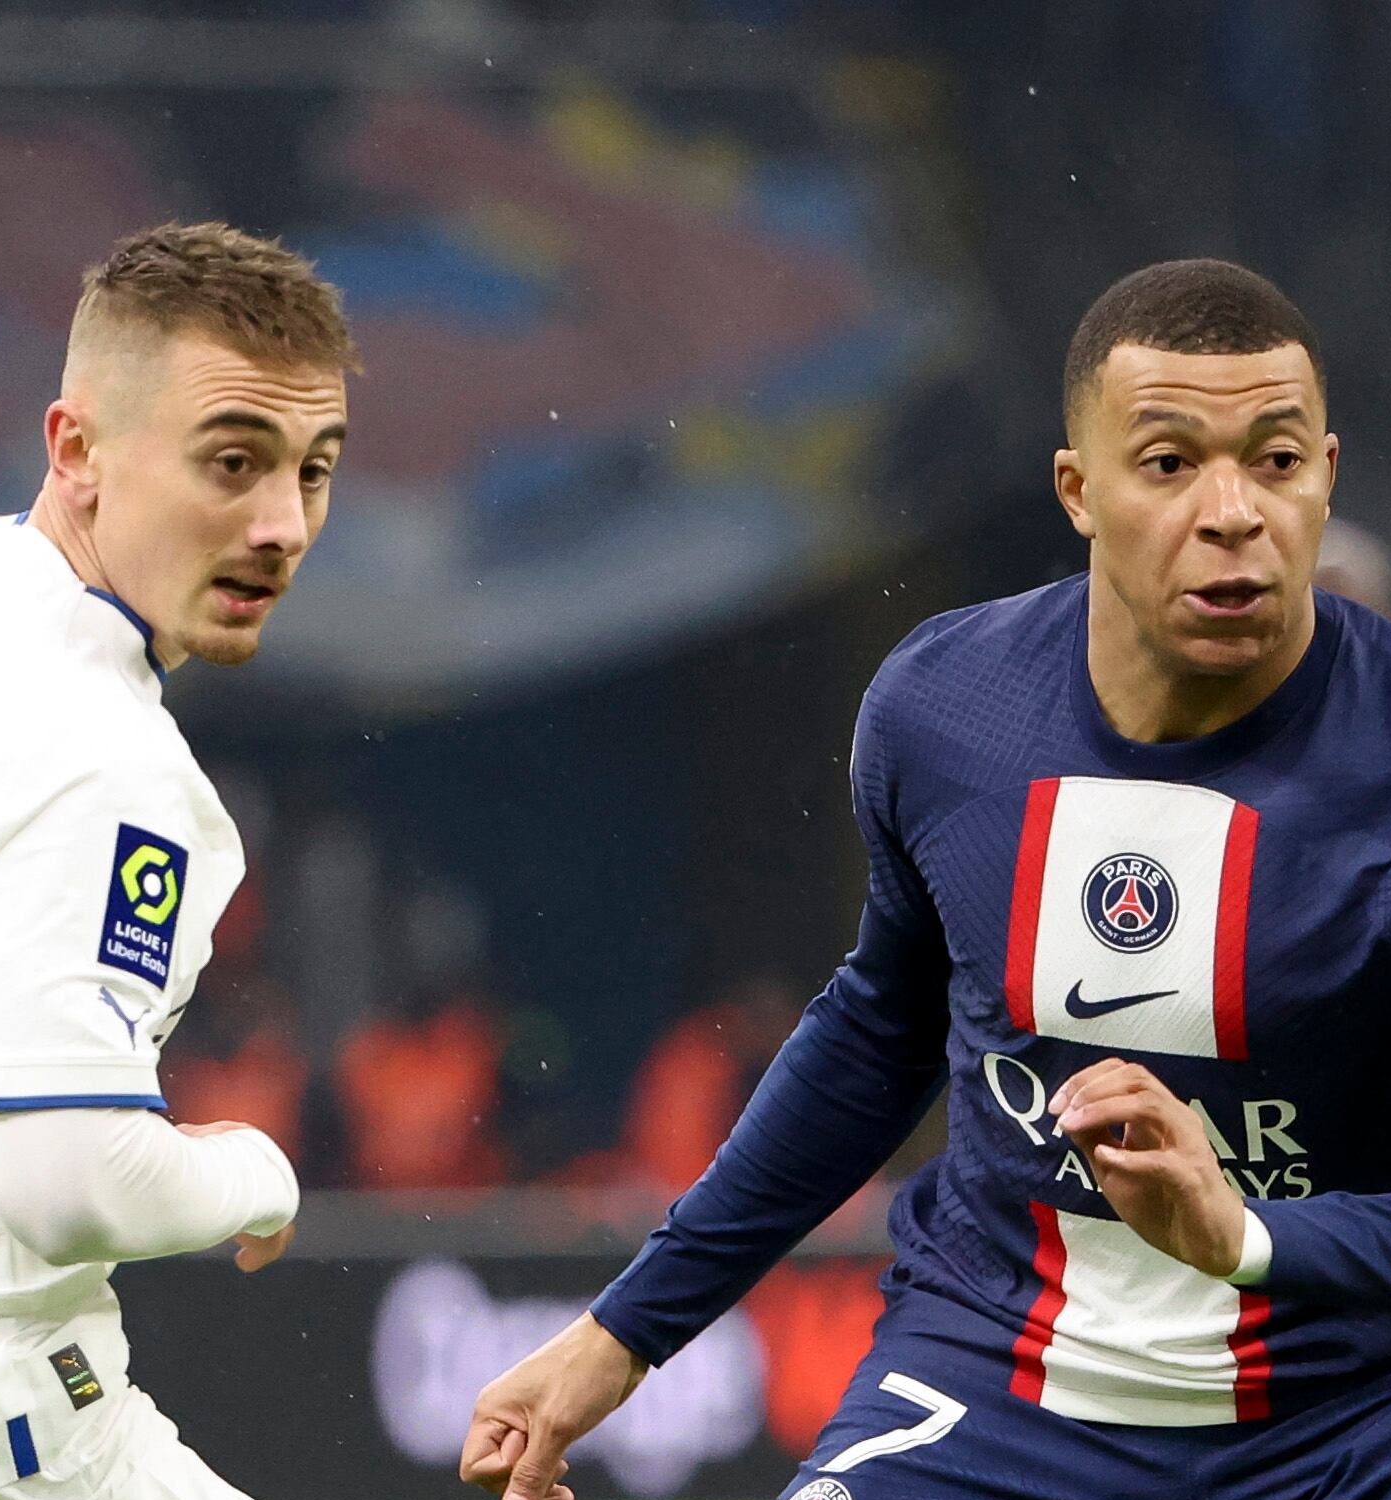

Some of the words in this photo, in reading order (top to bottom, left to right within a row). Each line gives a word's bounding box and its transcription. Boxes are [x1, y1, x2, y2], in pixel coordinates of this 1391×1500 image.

[1101, 860, 1162, 887] PARIS
[106, 938, 140, 962] Uber
[115, 920, 161, 951] LIGUE
[161, 941, 168, 955] 1
[816, 1371, 969, 1473] 7
